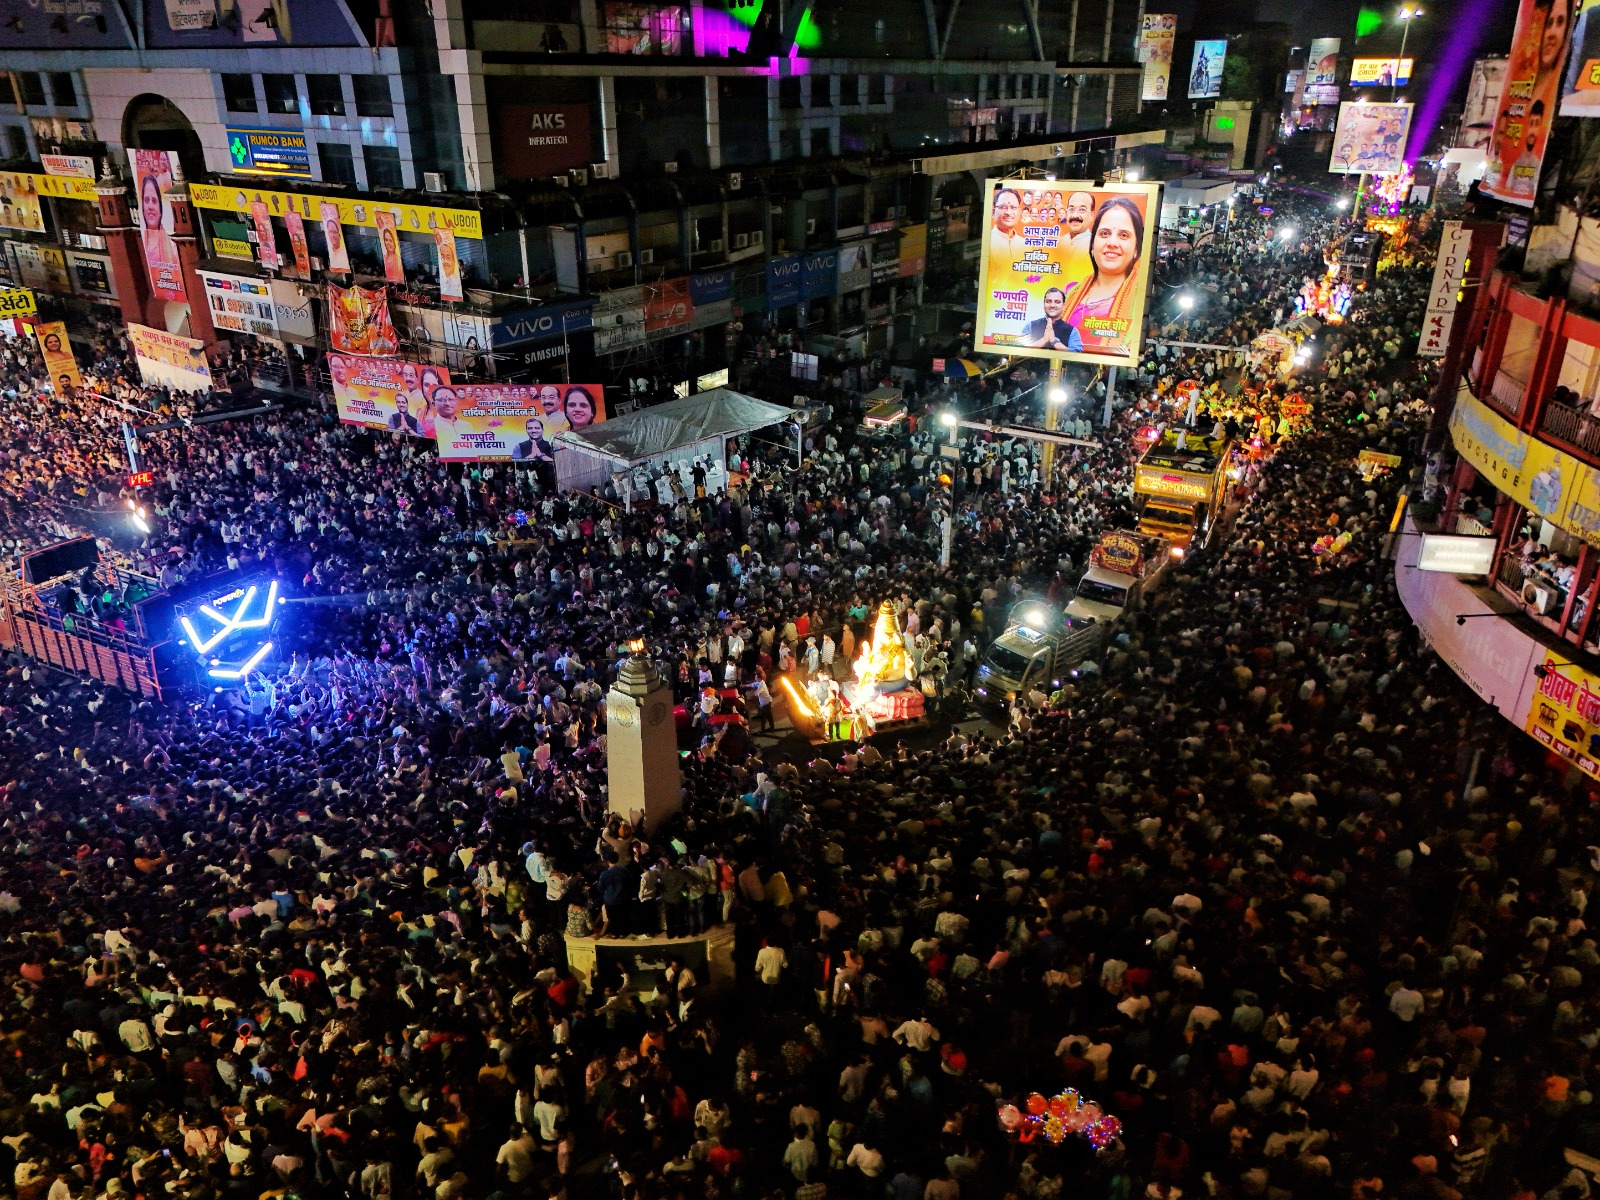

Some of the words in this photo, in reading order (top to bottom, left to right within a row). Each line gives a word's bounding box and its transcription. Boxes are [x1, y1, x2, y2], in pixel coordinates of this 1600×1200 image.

[531, 113, 565, 130] AKS
[250, 135, 280, 147] RUMCO
[281, 136, 306, 147] BANK
[529, 135, 569, 146] INFRATECH
[46, 158, 69, 168] MOBILE
[1024, 227, 1040, 236] आप
[1041, 226, 1060, 237] सभी
[1024, 235, 1045, 247] भक्तों
[1045, 238, 1058, 248] का
[1025, 249, 1049, 262] हार्दिक
[1012, 260, 1051, 274] अभिनंदन
[1435, 230, 1463, 309] GIRNAR
[993, 290, 1028, 303] गणपति
[1007, 302, 1028, 312] बप्पा
[994, 308, 1027, 321] मोरया!
[525, 344, 571, 365] SAMSUNG
[461, 406, 487, 417] हार्दिक
[488, 406, 529, 417] अभिनंदन
[460, 431, 495, 443] गणपति
[451, 441, 473, 449] बप्पा
[474, 439, 506, 449] मोरया!
[1450, 660, 1471, 681] CONTACT
[1469, 678, 1484, 694] LENS
